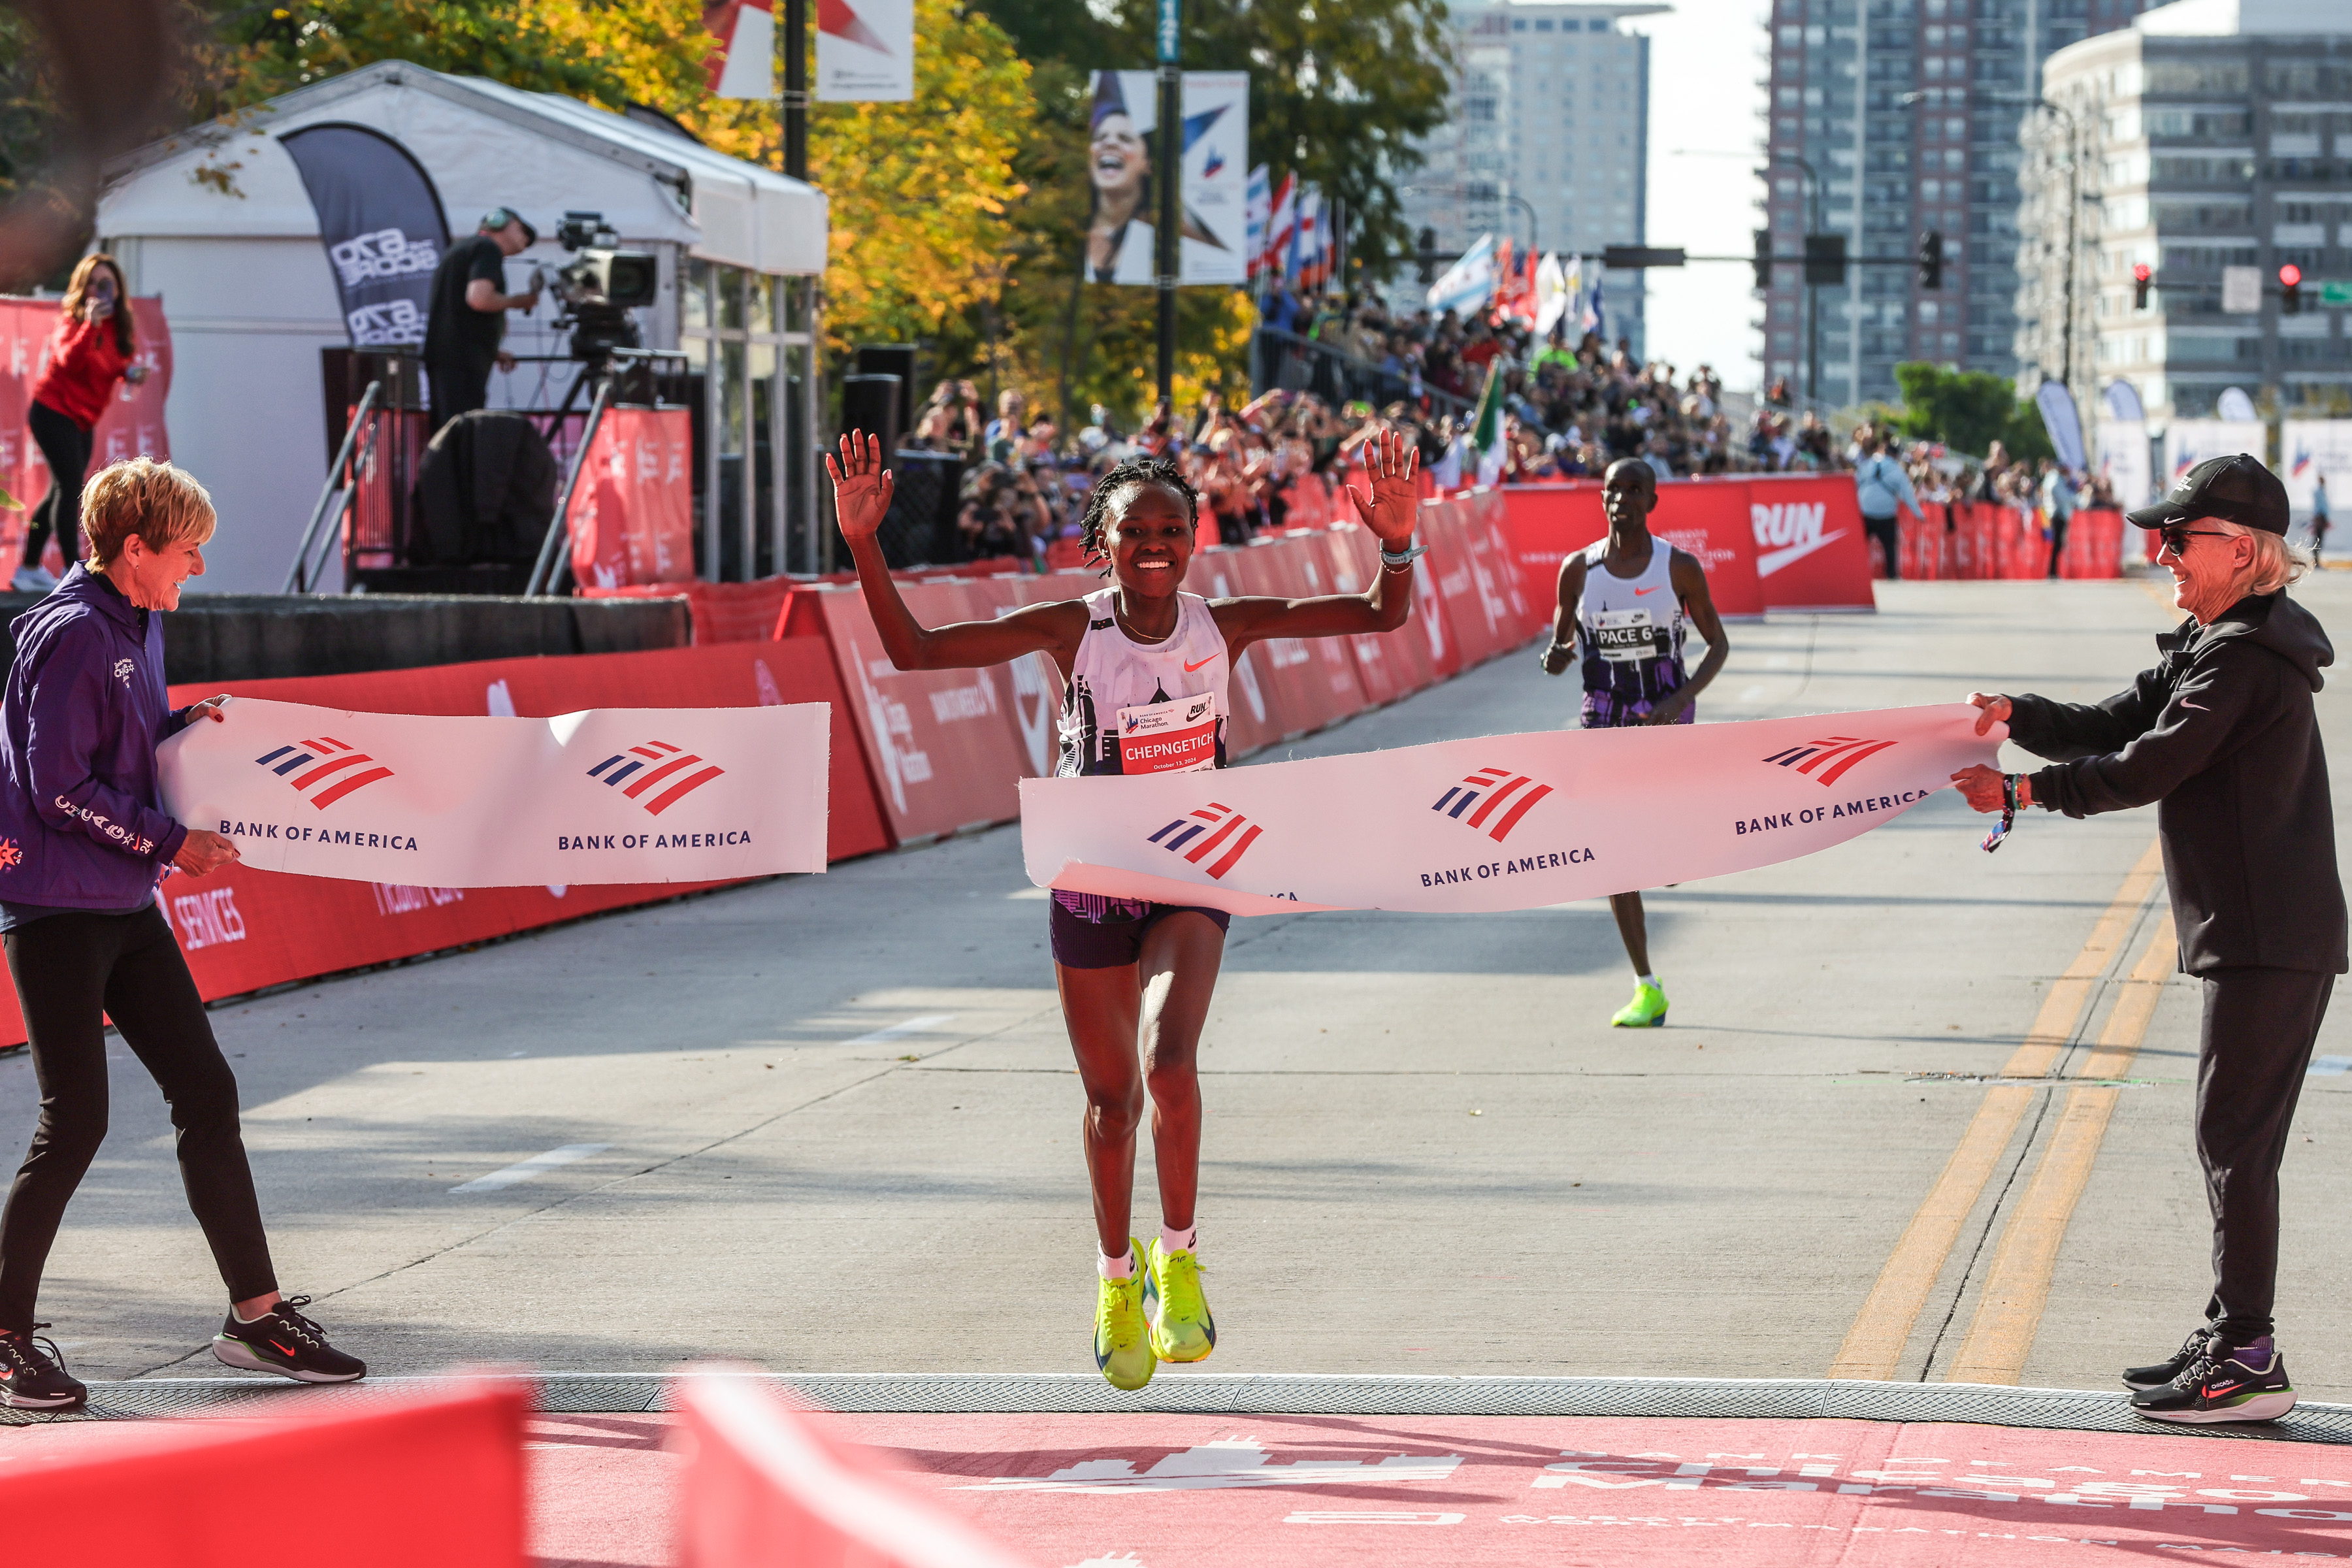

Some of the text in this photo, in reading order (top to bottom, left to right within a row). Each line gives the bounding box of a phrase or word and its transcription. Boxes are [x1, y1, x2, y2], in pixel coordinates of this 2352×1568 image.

[1750, 501, 1827, 548] RUN
[1599, 627, 1653, 644] PACE 6
[1190, 702, 1207, 715] RUN
[1126, 730, 1214, 760] CHEPNGETICH
[1735, 789, 1929, 835] BANK OF AMERICA
[140, 838, 154, 855] 24
[220, 819, 418, 851] BANK OF AMERICA
[558, 830, 751, 851] BANK OF AMERICA
[1420, 847, 1595, 887] BANK OF AMERICA
[1560, 1450, 1845, 1461] BANK
[1884, 1457, 2015, 1467] OF
[1544, 1462, 2310, 1501] Chicago
[1747, 1522, 2117, 1546] MARATHON
[2155, 1543, 2352, 1559] MAJO
